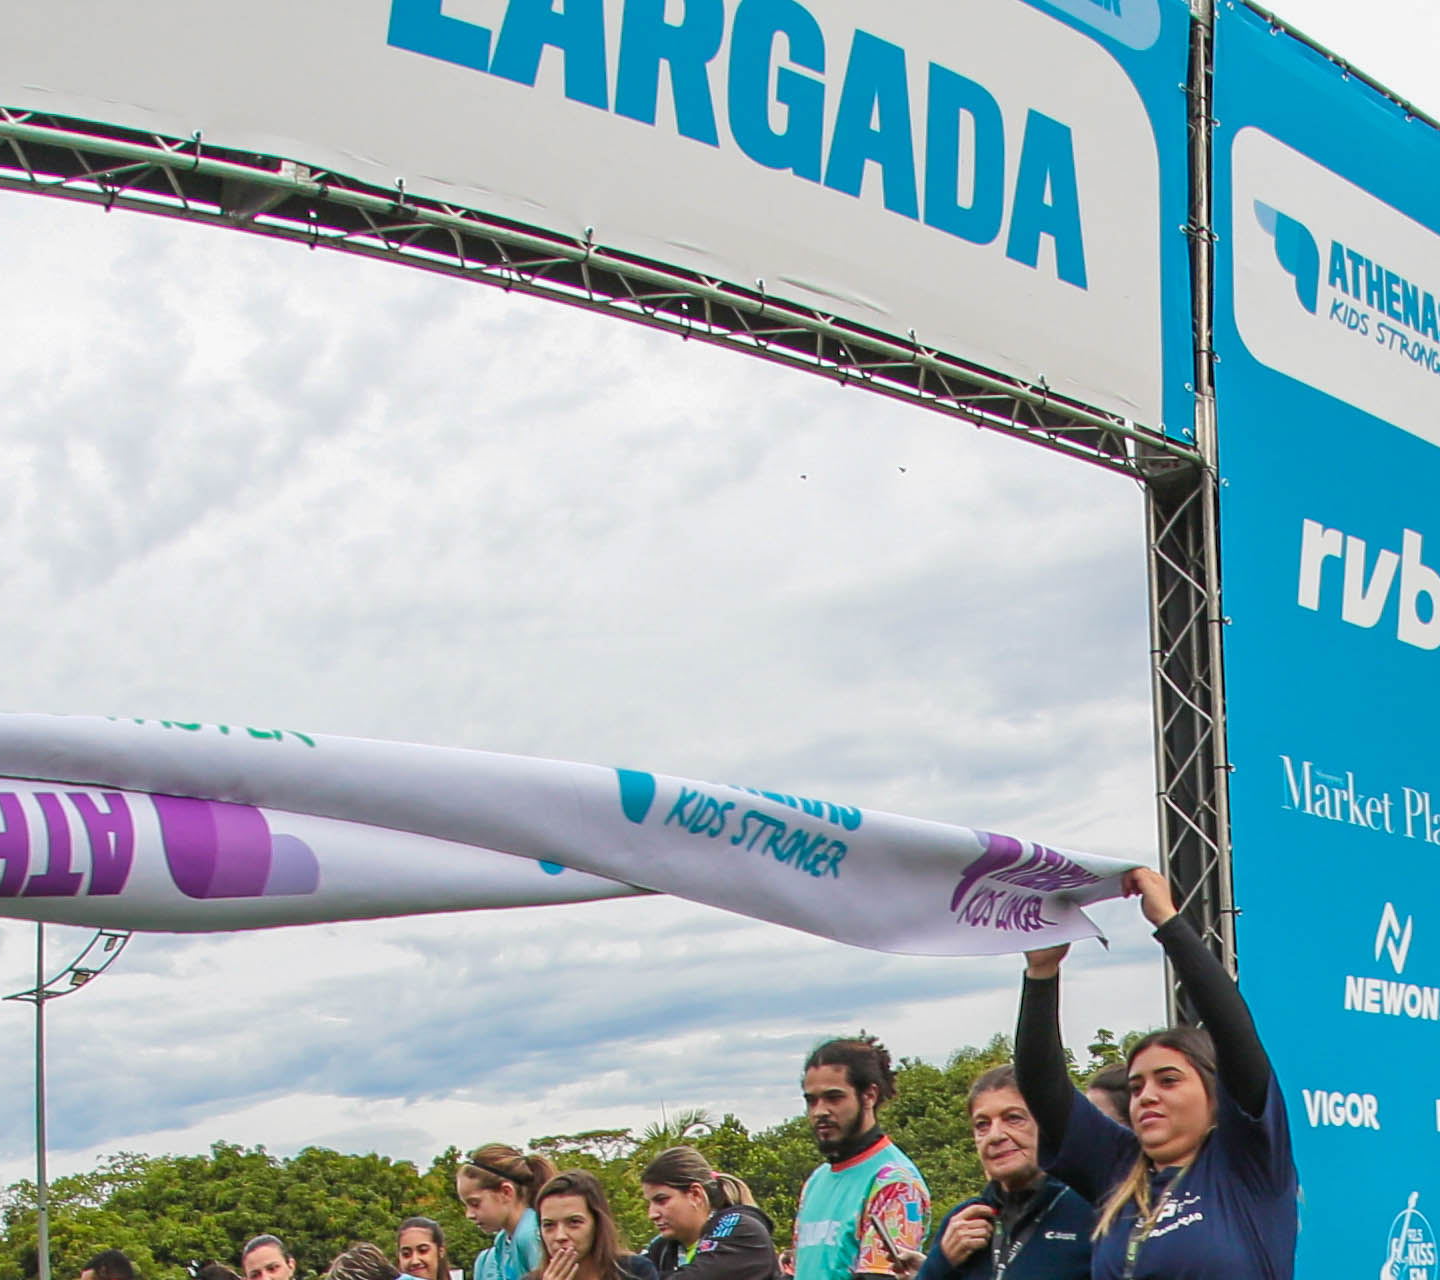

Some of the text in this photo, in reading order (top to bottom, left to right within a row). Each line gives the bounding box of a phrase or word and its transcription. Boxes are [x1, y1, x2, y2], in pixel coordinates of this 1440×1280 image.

[1328, 297, 1370, 337] KIDS
[664, 785, 737, 838] KIDS
[1279, 754, 1396, 835] Market
[1343, 974, 1440, 1021] NEWON
[1302, 1088, 1381, 1131] VIGOR
[1407, 1242, 1435, 1267] KISS
